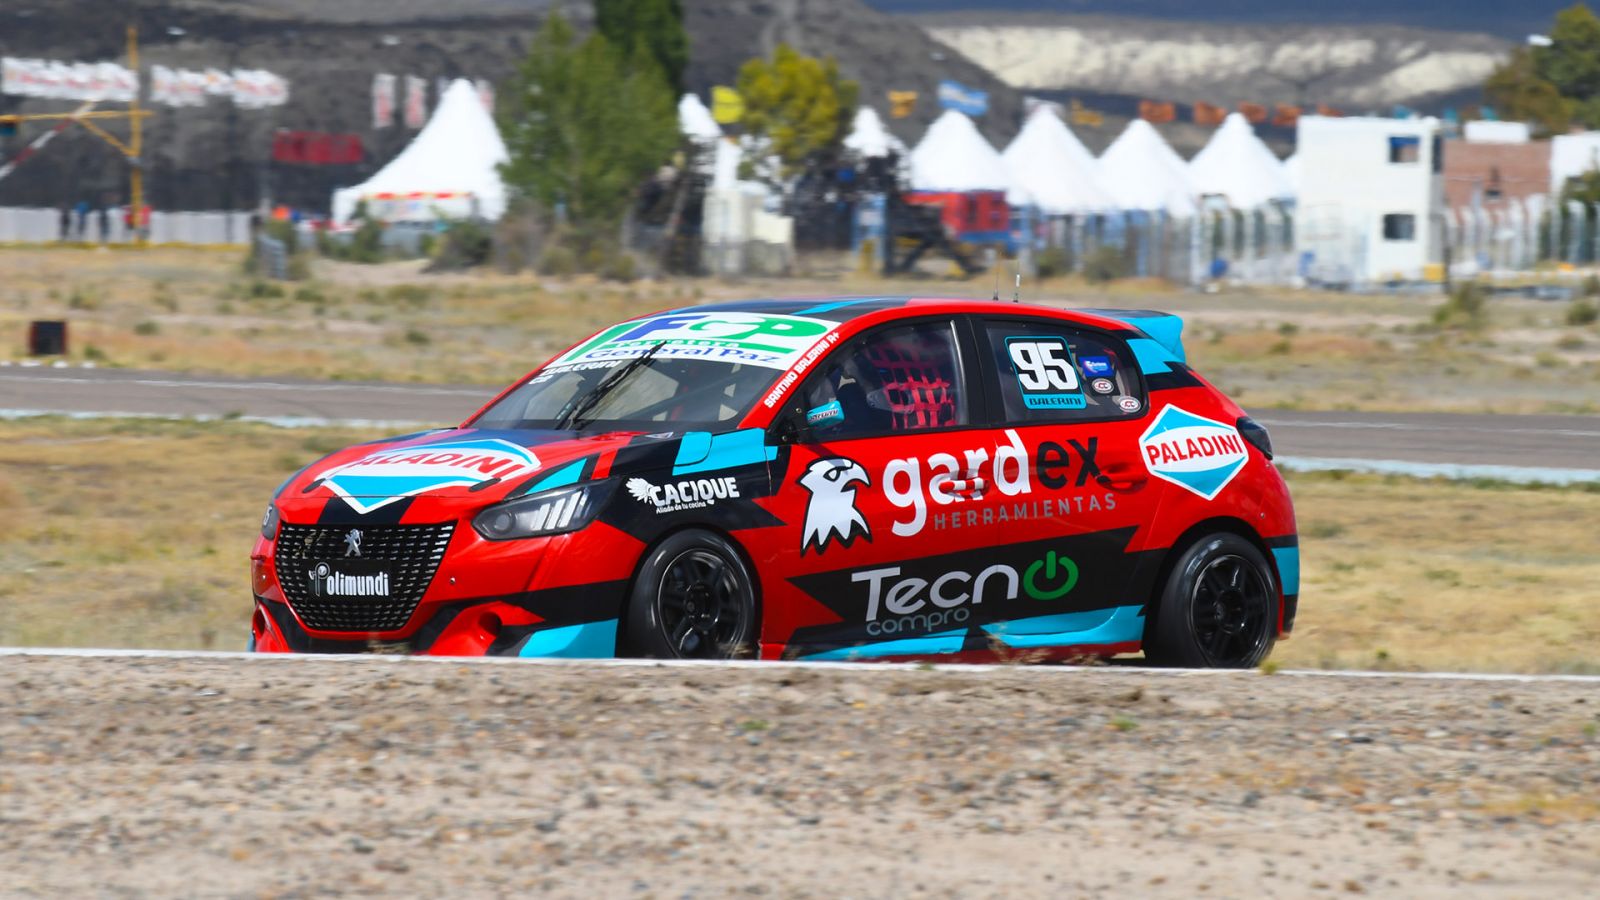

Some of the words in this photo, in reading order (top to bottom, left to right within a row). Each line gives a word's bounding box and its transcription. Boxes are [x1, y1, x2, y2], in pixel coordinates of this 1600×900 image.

[585, 346, 713, 359] General
[719, 347, 780, 363] Paz
[1009, 342, 1079, 390] 95
[764, 370, 798, 408] SANTINO
[794, 340, 830, 374] BALERINI
[1029, 397, 1082, 406] BALERINI
[1145, 434, 1243, 466] PALADINI
[346, 453, 526, 480] ALADINI
[649, 477, 740, 507] CACIQUE
[882, 429, 1110, 537] gardex
[934, 492, 1117, 530] HERRAMIENTAS
[318, 562, 390, 597] Polimundi
[866, 607, 970, 636] compro
